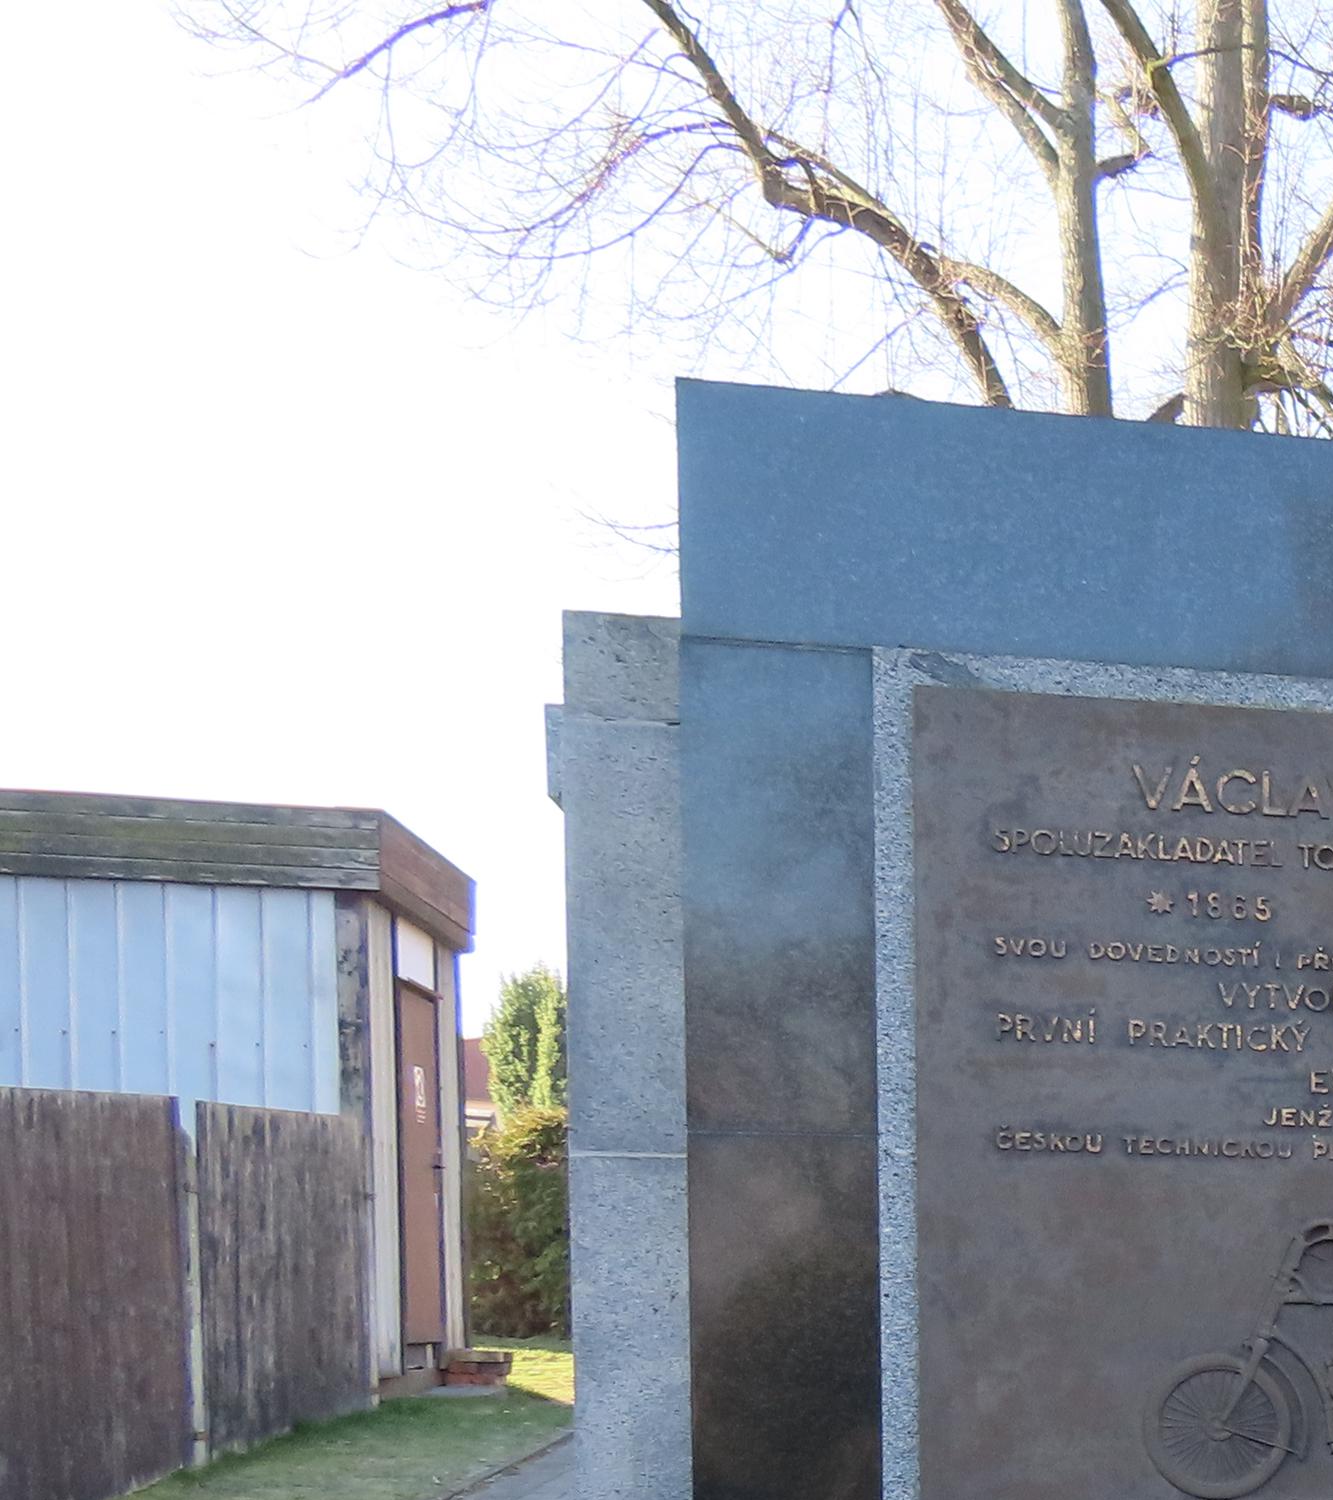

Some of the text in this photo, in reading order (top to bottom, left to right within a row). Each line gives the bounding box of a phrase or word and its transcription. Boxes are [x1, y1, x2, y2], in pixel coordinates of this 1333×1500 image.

[992, 829, 1284, 868] SPOLUZAKLADATEL
[1186, 890, 1274, 922] 1865
[993, 936, 1067, 959] SVOU
[1089, 940, 1262, 969] DOVEDNOSTÍ
[996, 1008, 1097, 1044] PRVNÍ
[1127, 1019, 1312, 1052] PRAKTICKÝ
[1262, 1103, 1333, 1128] JENŽ
[994, 1123, 1103, 1153] ČESKOU
[1121, 1135, 1294, 1160] TECHNICKOU
